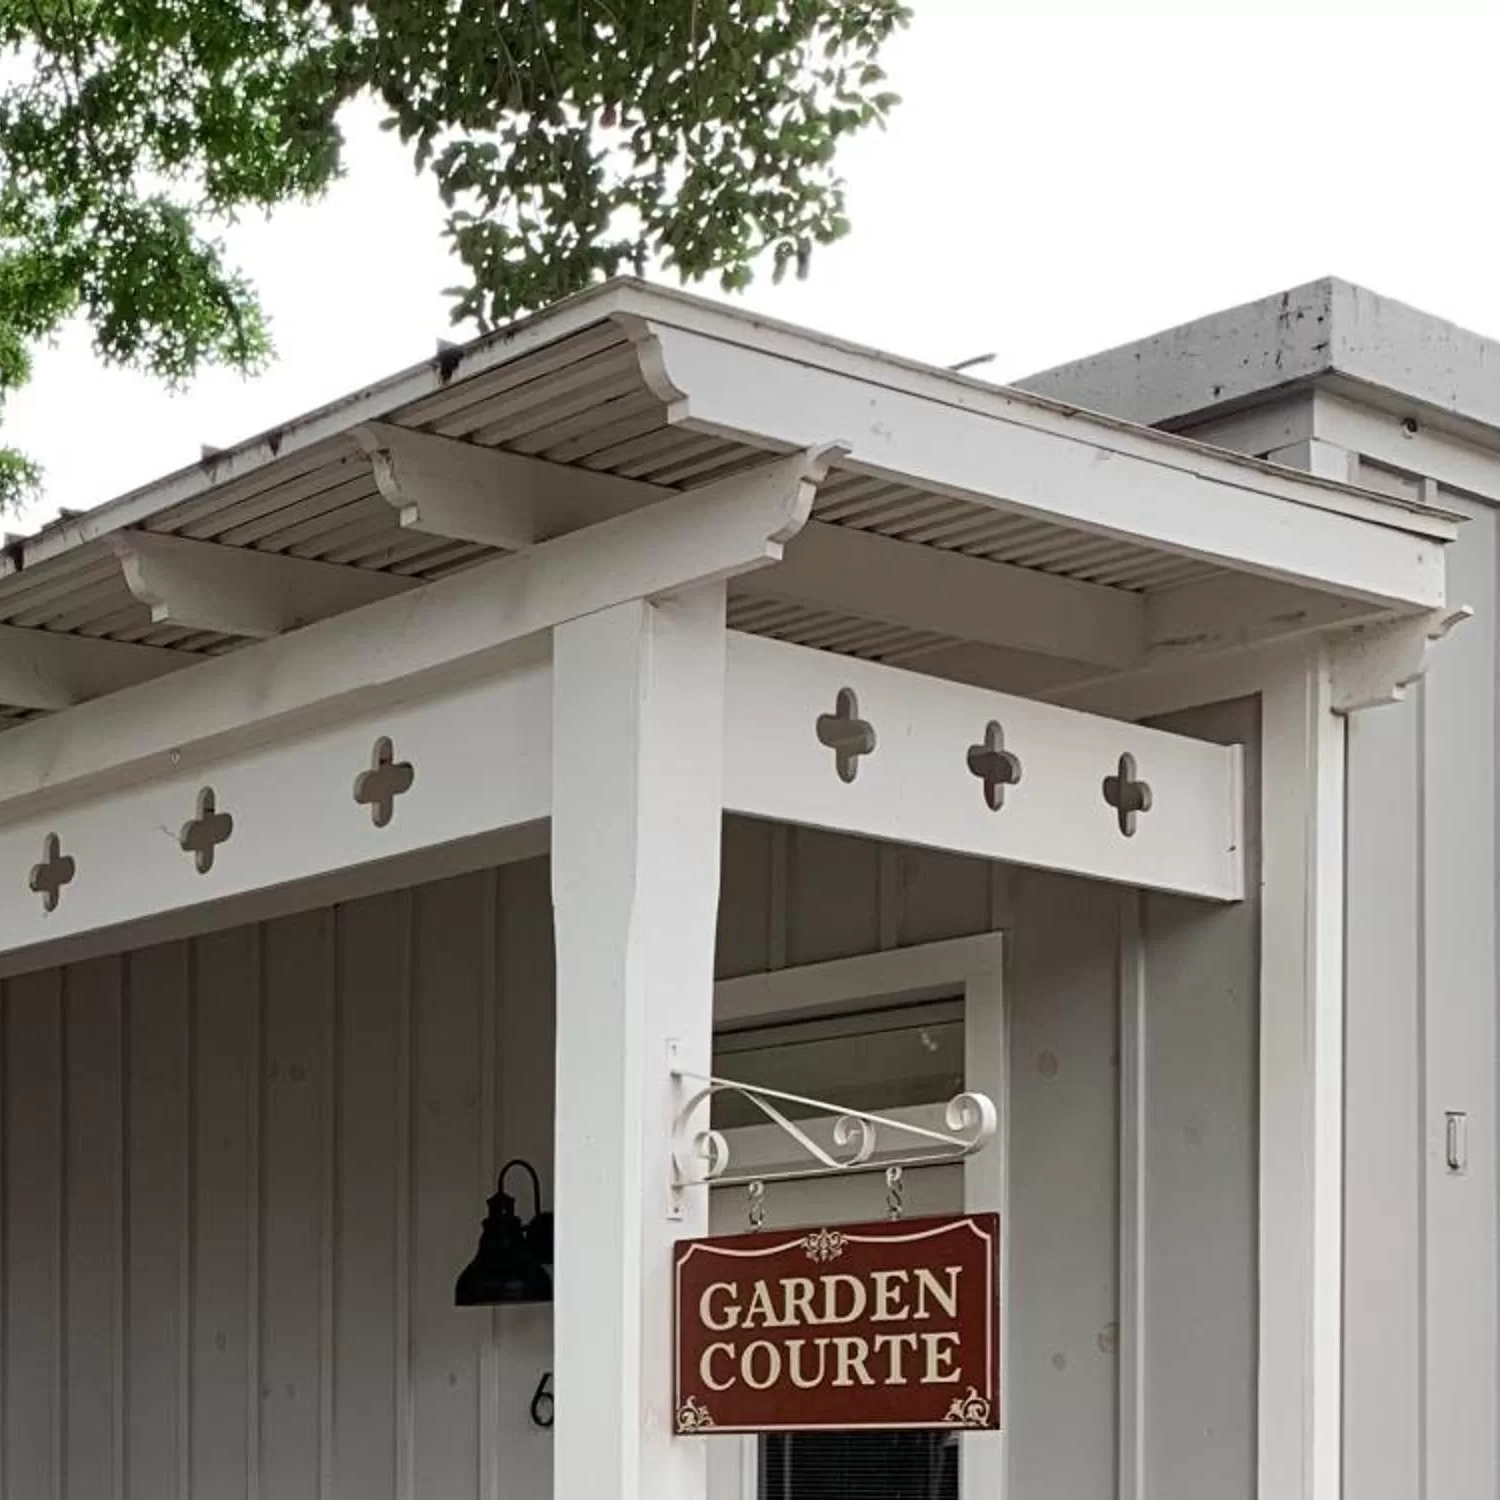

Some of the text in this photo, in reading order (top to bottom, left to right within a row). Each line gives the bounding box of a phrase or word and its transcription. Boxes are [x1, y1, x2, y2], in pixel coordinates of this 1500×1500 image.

[700, 1266, 963, 1331] GARDEN
[700, 1332, 962, 1391] COURTE
[531, 1372, 554, 1427] 6
